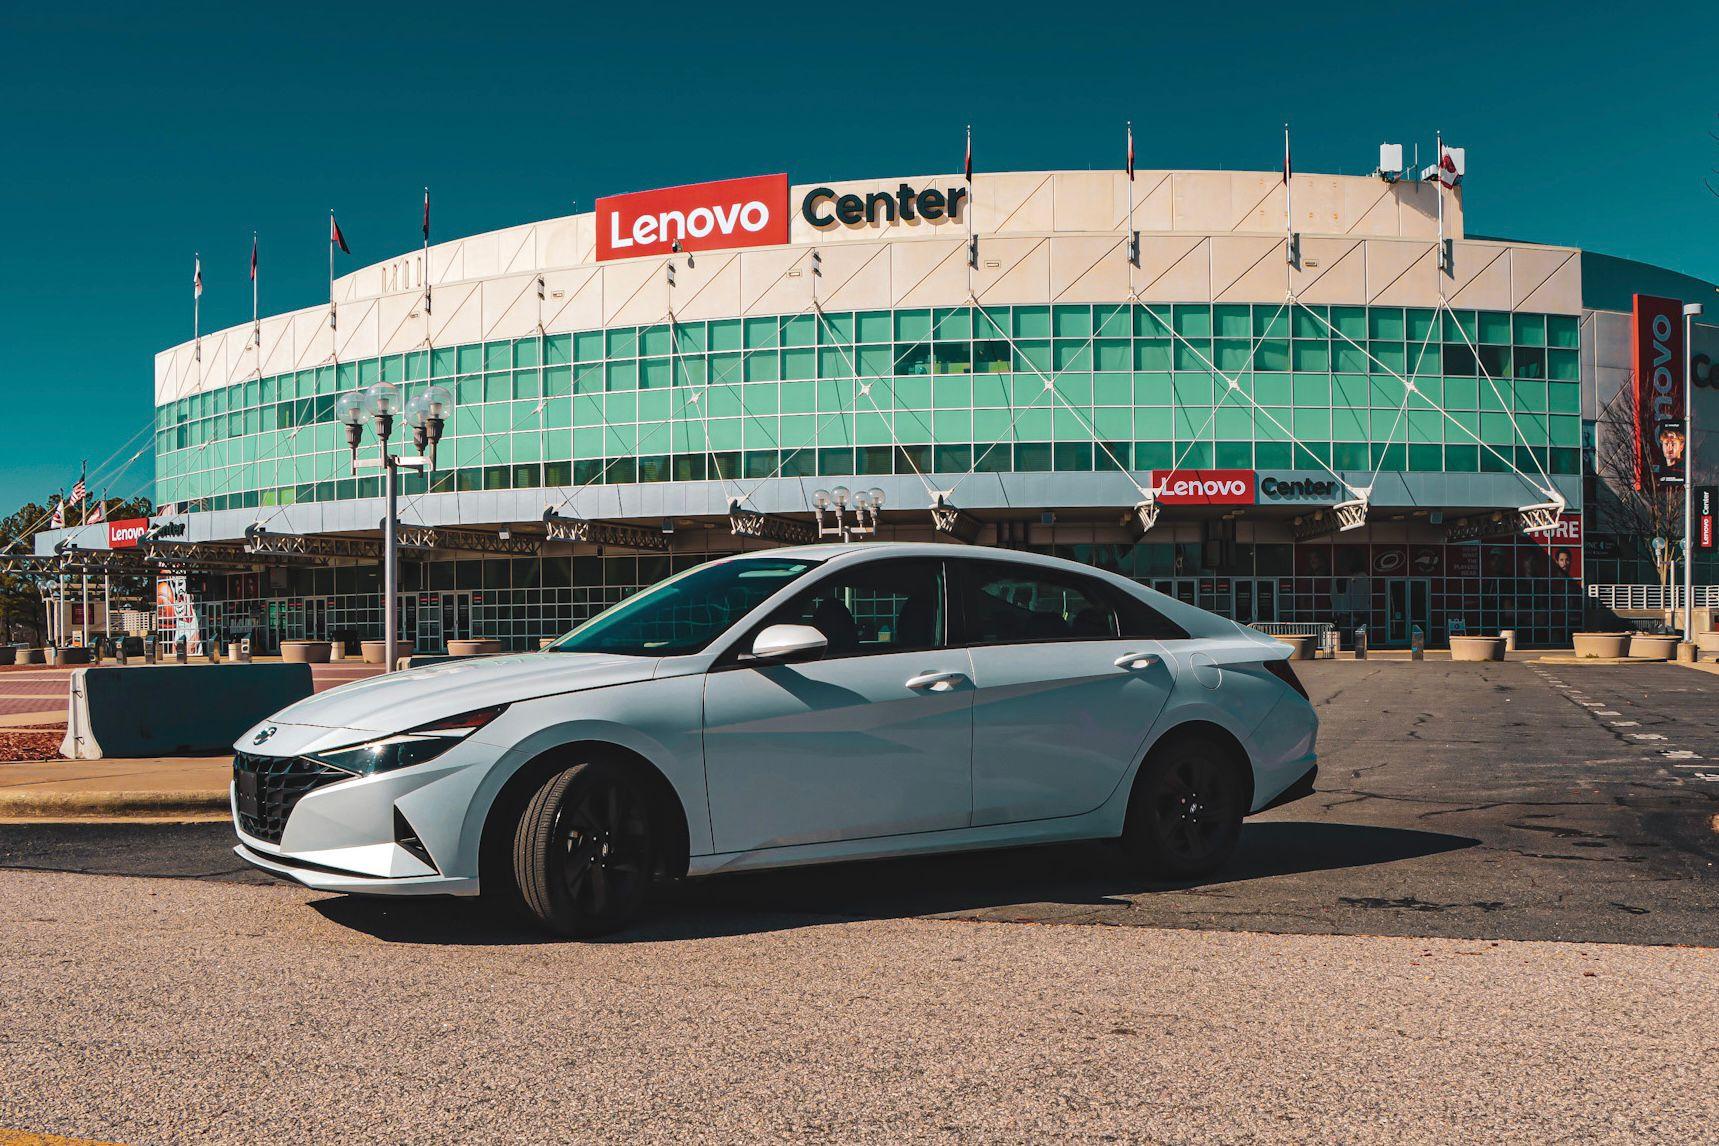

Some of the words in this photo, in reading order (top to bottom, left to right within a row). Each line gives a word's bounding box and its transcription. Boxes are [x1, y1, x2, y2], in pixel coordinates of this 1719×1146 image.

[611, 200, 769, 249] Lenovo
[801, 183, 966, 227] Center
[1653, 314, 1673, 449] novo
[1161, 477, 1246, 496] Lenovo
[1261, 476, 1336, 496] Center
